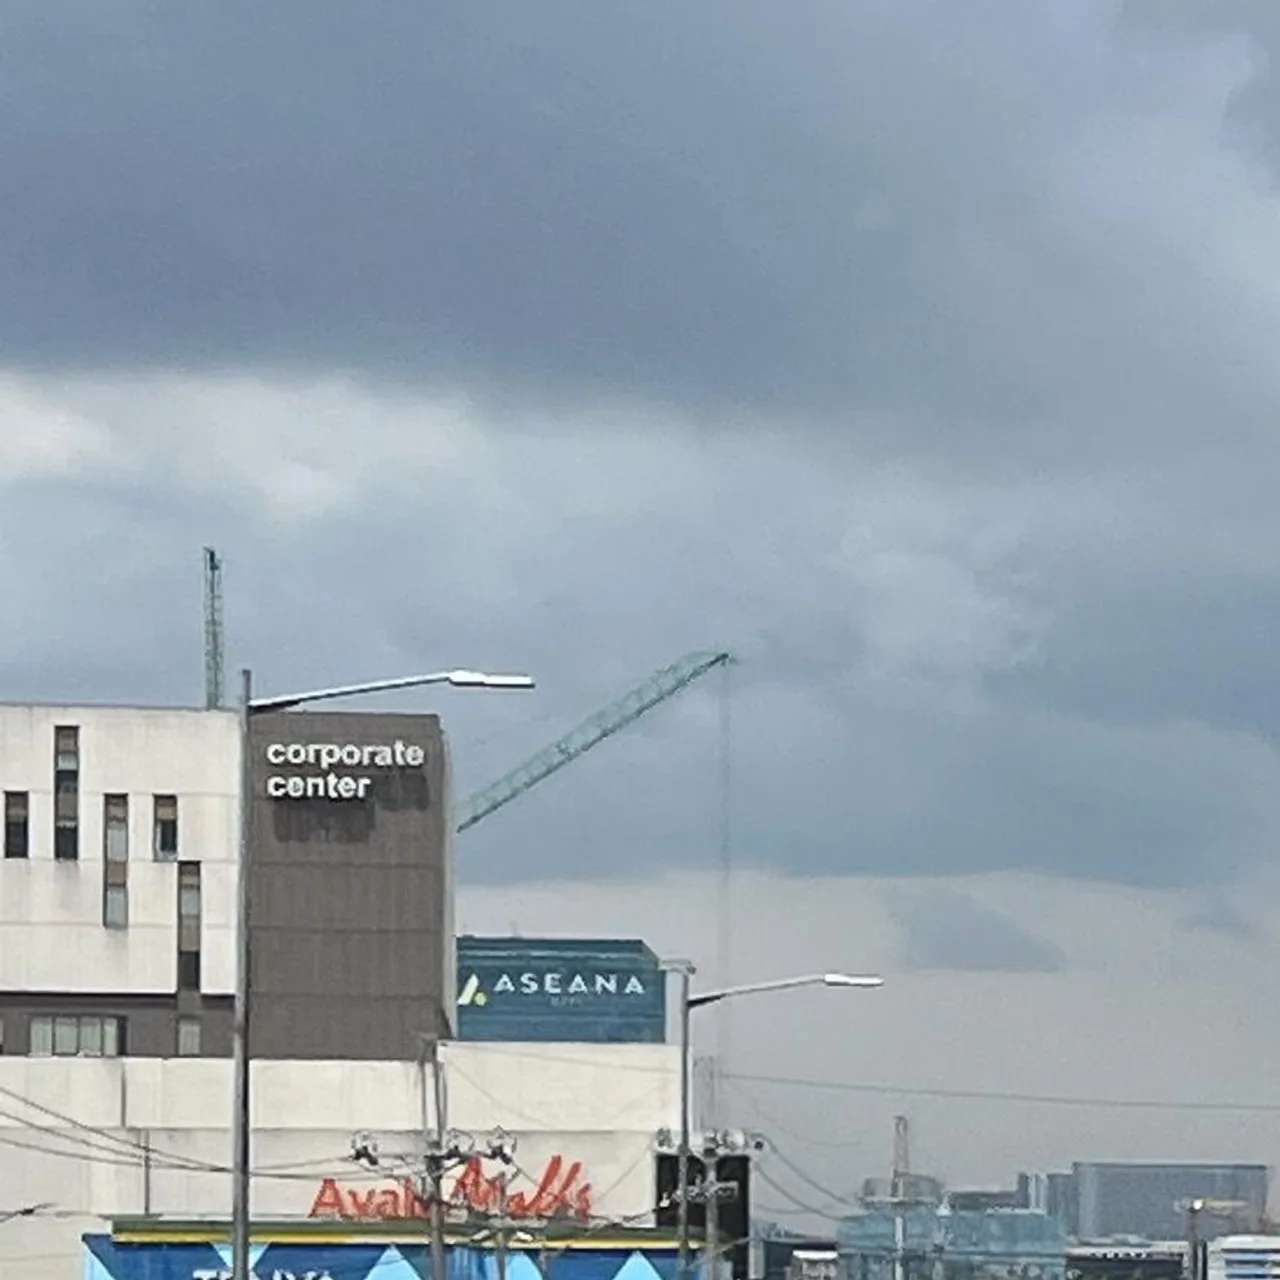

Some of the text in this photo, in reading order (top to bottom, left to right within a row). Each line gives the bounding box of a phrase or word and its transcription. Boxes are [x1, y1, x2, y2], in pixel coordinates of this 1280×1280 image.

[266, 739, 425, 770] corporate
[266, 772, 372, 798] center
[492, 973, 646, 994] ASEANA
